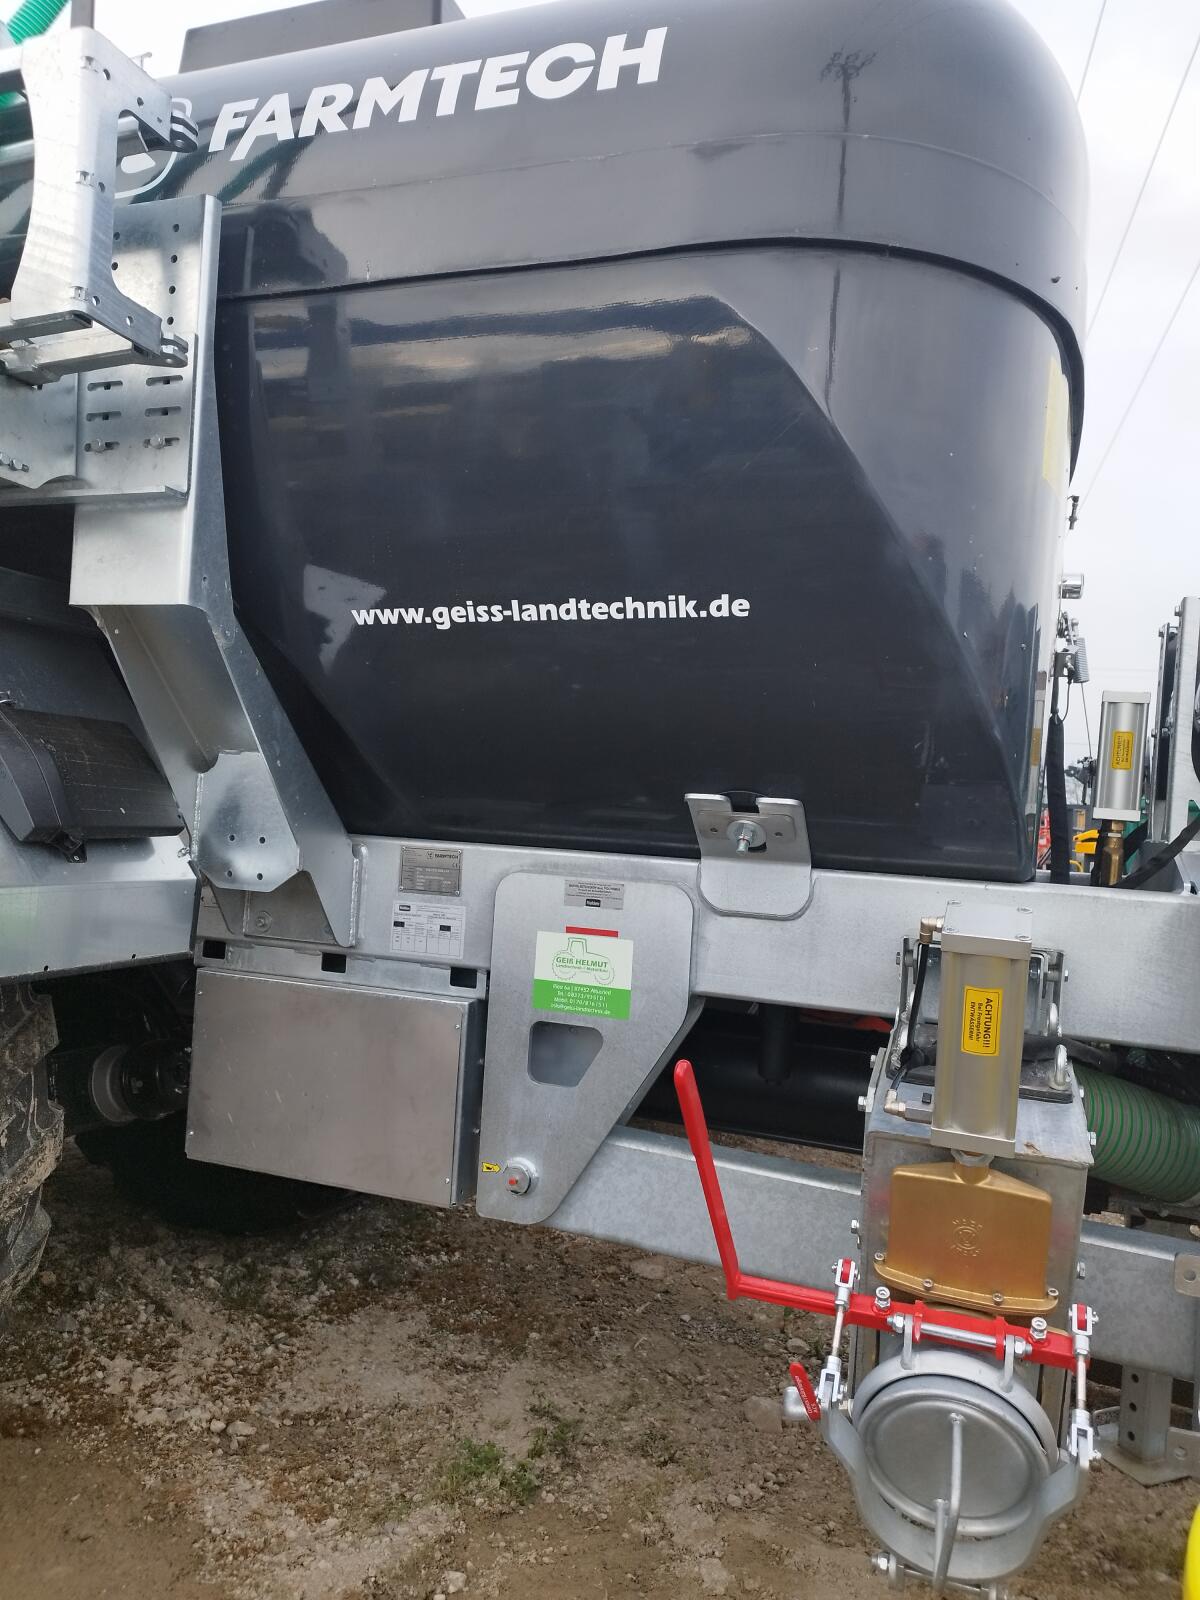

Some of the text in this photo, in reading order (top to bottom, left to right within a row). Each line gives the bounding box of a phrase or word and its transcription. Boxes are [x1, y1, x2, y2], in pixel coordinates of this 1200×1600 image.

[208, 26, 668, 162] FARMTECH
[351, 594, 751, 630] www.geiss-landtechnik.de
[575, 959, 608, 968] HELMUT
[983, 997, 993, 1048] ACHTUNG!!!
